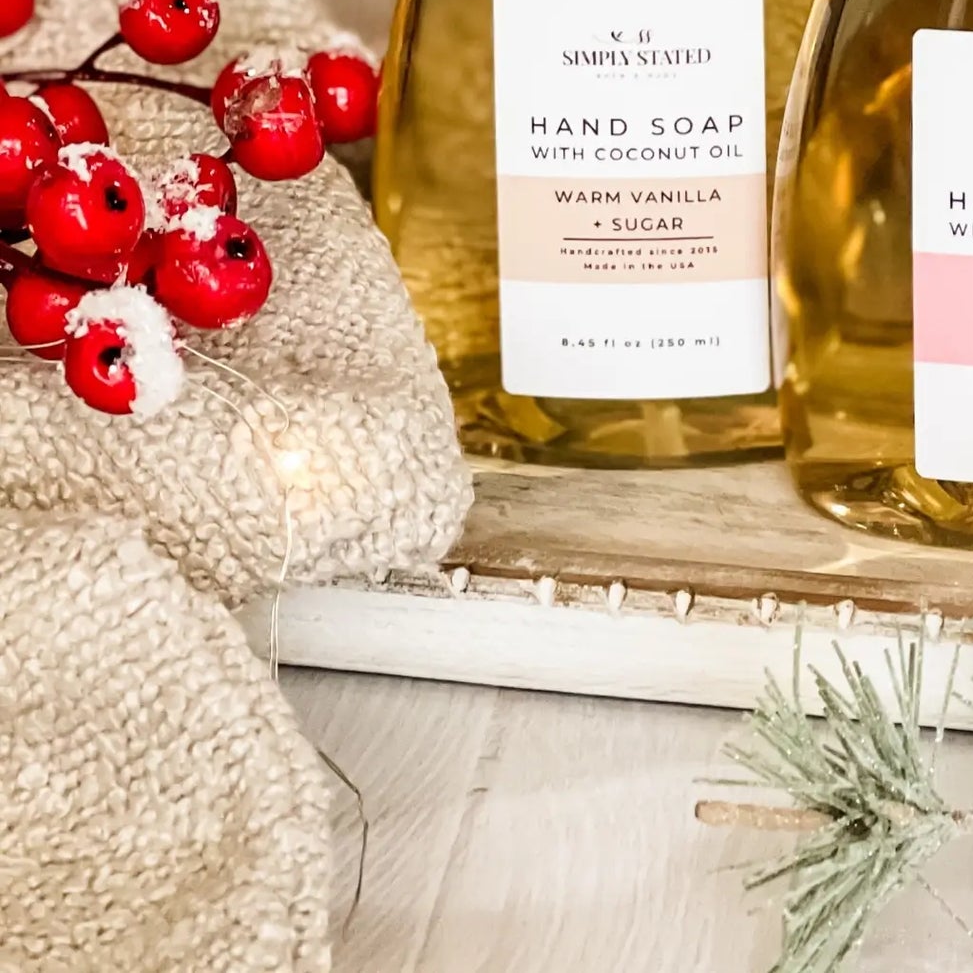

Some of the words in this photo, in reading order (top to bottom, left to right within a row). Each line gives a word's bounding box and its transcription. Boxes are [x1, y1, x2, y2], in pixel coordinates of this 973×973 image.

[563, 49, 630, 66] SIMPLY
[637, 48, 711, 66] STATED
[531, 116, 627, 136] HAND
[651, 115, 743, 136] SOAP
[531, 146, 584, 160] WITH
[595, 146, 700, 160] COCONUT
[710, 145, 743, 158] OIL
[555, 190, 621, 204] WARM
[631, 189, 721, 203] VANILLA
[612, 217, 683, 231] SUGAR
[560, 247, 642, 256] Handcrafted
[691, 246, 718, 255] 2015
[584, 262, 616, 270] Made
[623, 262, 635, 270] in
[642, 262, 663, 270] the
[562, 338, 595, 347] 8.45
[604, 339, 615, 347] fl
[625, 339, 641, 347] oz
[651, 338, 685, 349] (250
[695, 336, 720, 347] ml)
